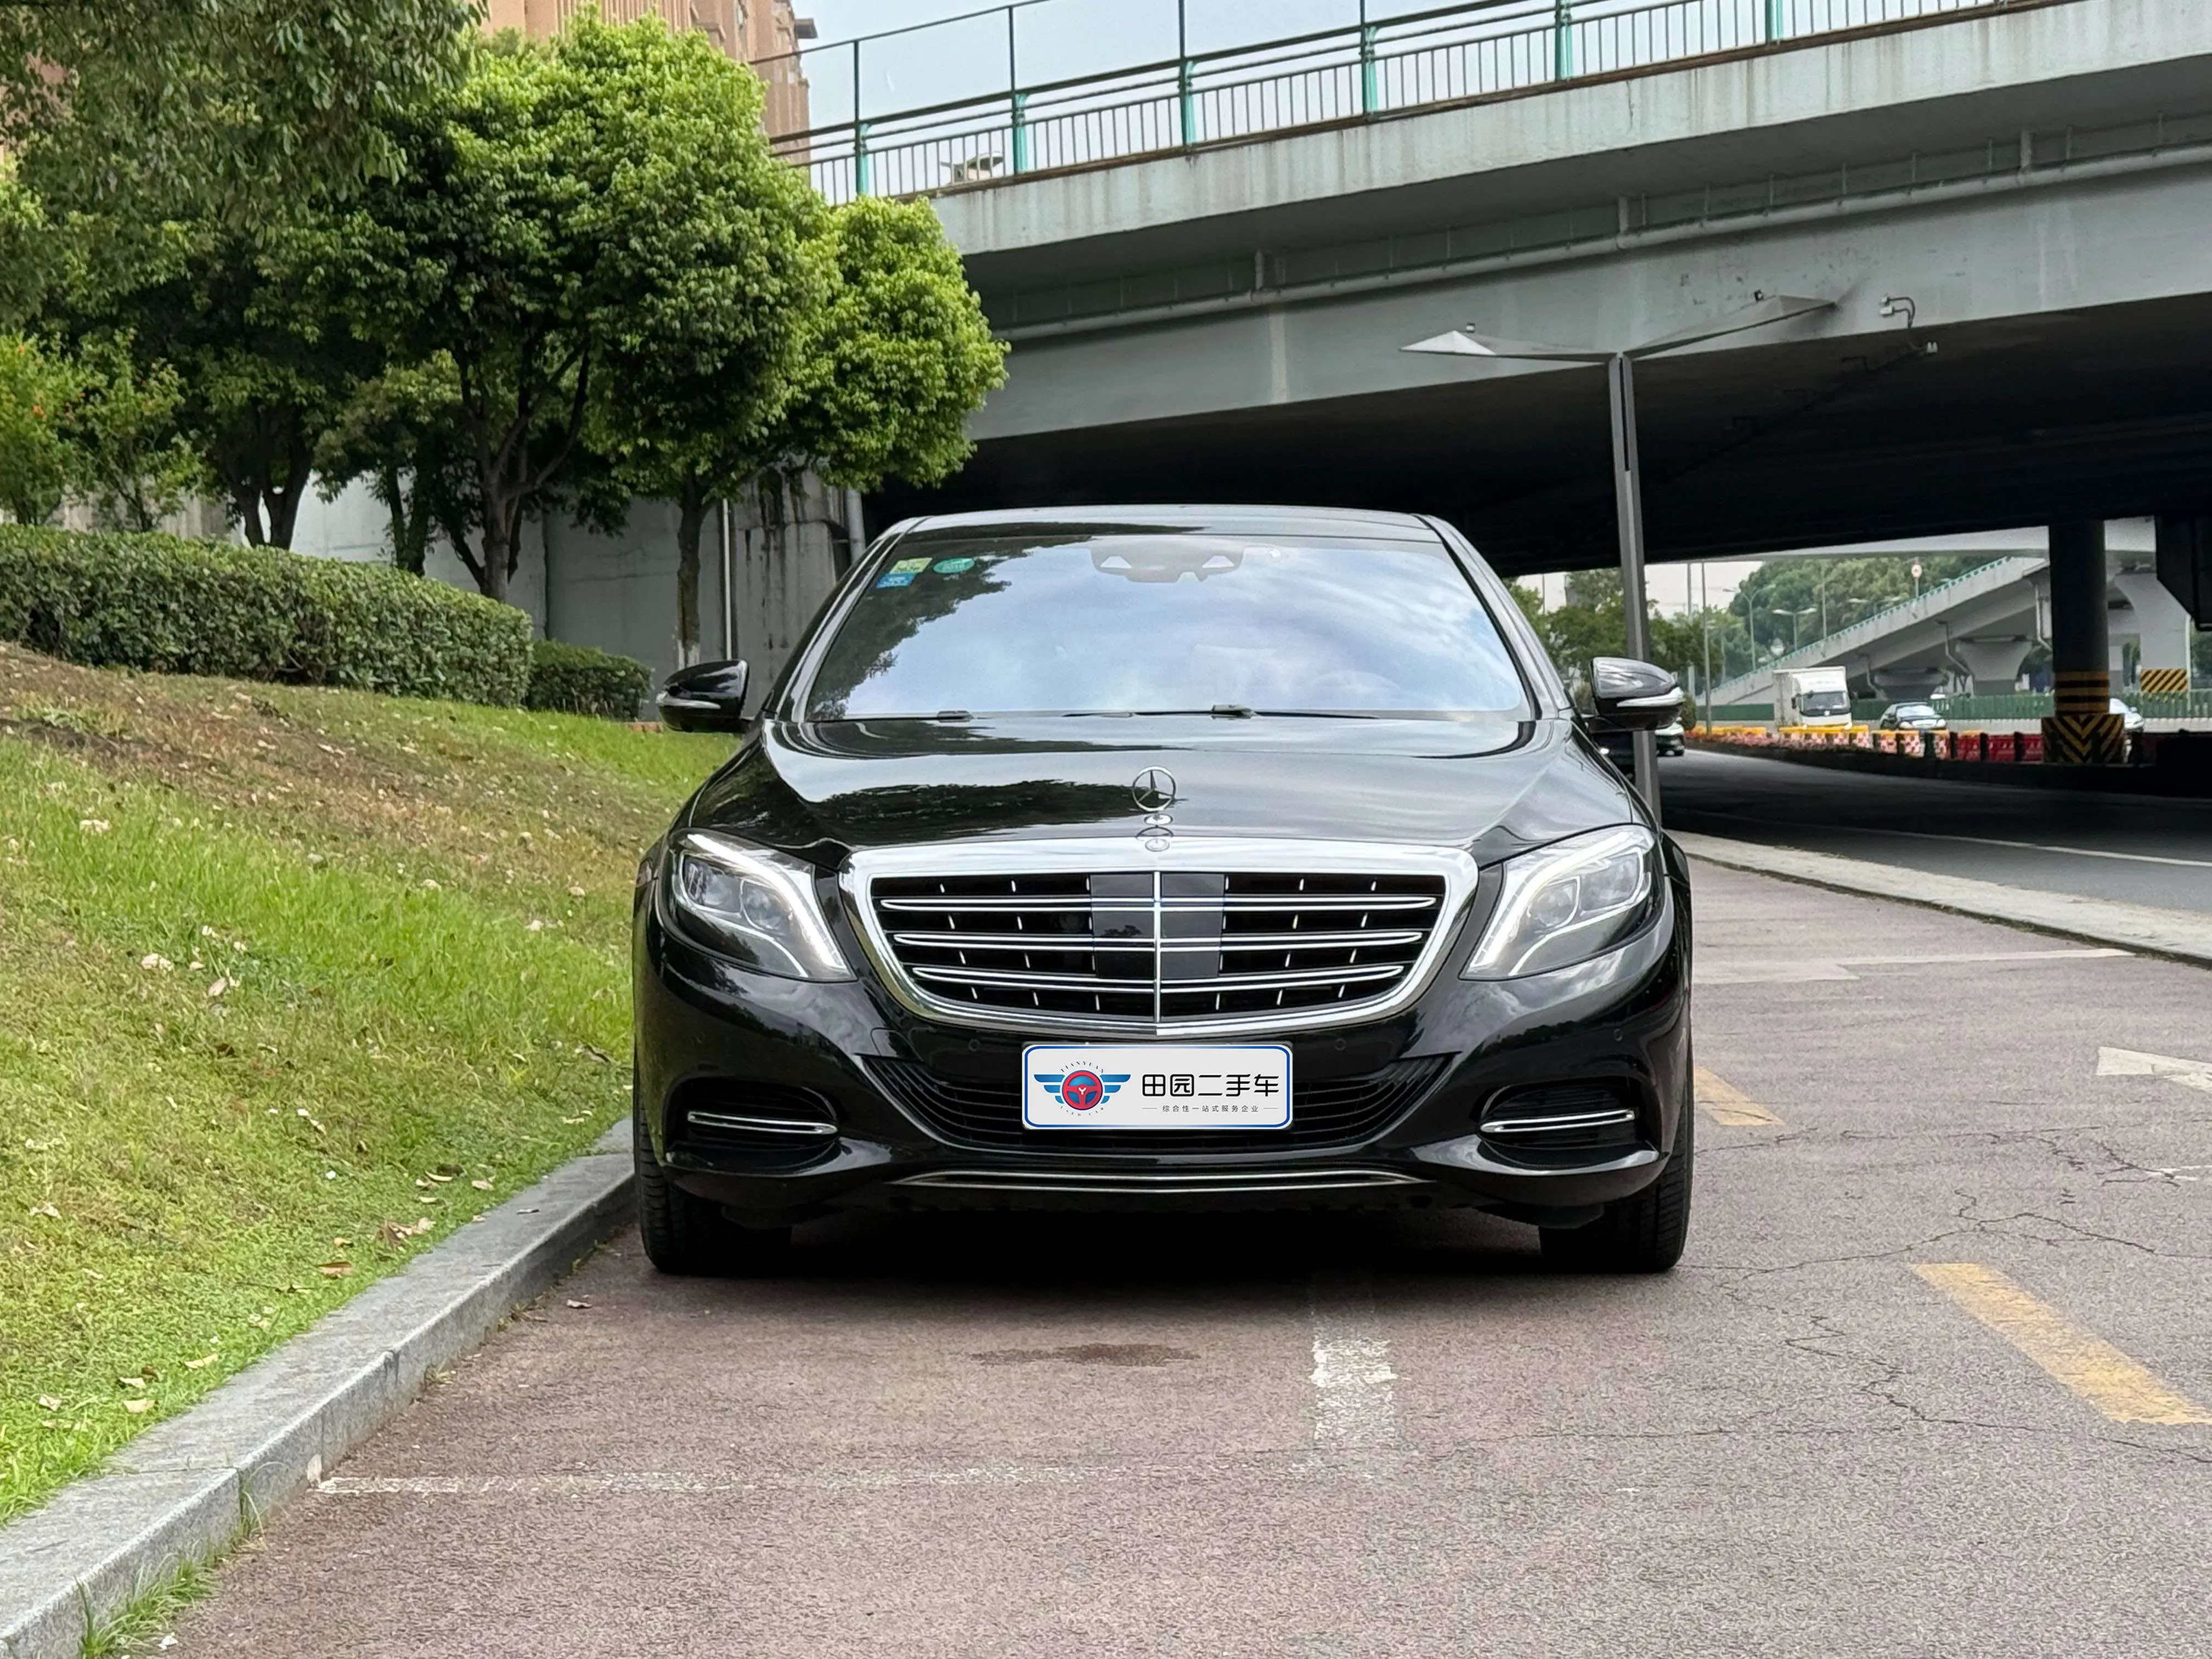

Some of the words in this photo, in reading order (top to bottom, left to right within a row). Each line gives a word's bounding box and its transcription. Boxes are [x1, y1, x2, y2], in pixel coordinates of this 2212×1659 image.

[1142, 1074, 1279, 1097] 田园二手车
